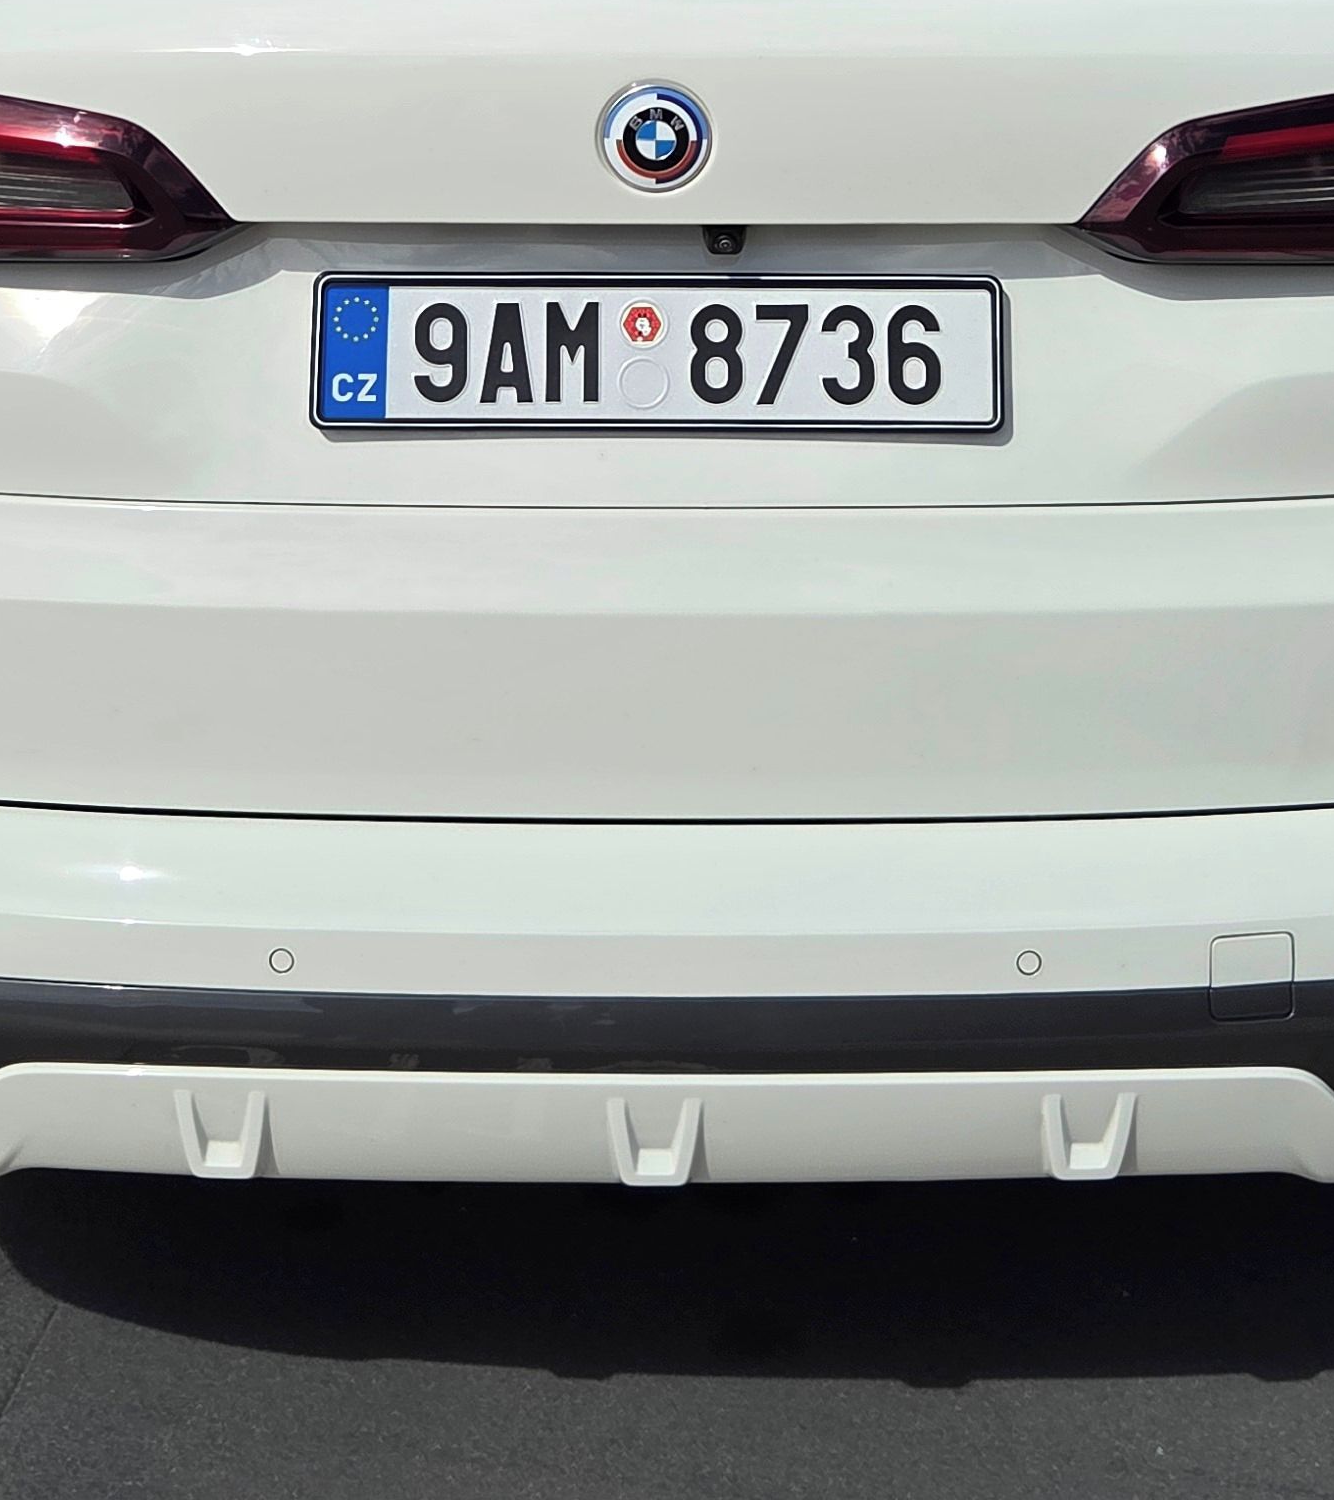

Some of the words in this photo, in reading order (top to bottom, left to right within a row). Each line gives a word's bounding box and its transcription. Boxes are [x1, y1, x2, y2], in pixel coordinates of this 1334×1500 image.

[629, 108, 685, 132] BMW
[414, 302, 600, 404] 9AM
[689, 303, 943, 407] 8736
[332, 373, 378, 402] CZ
